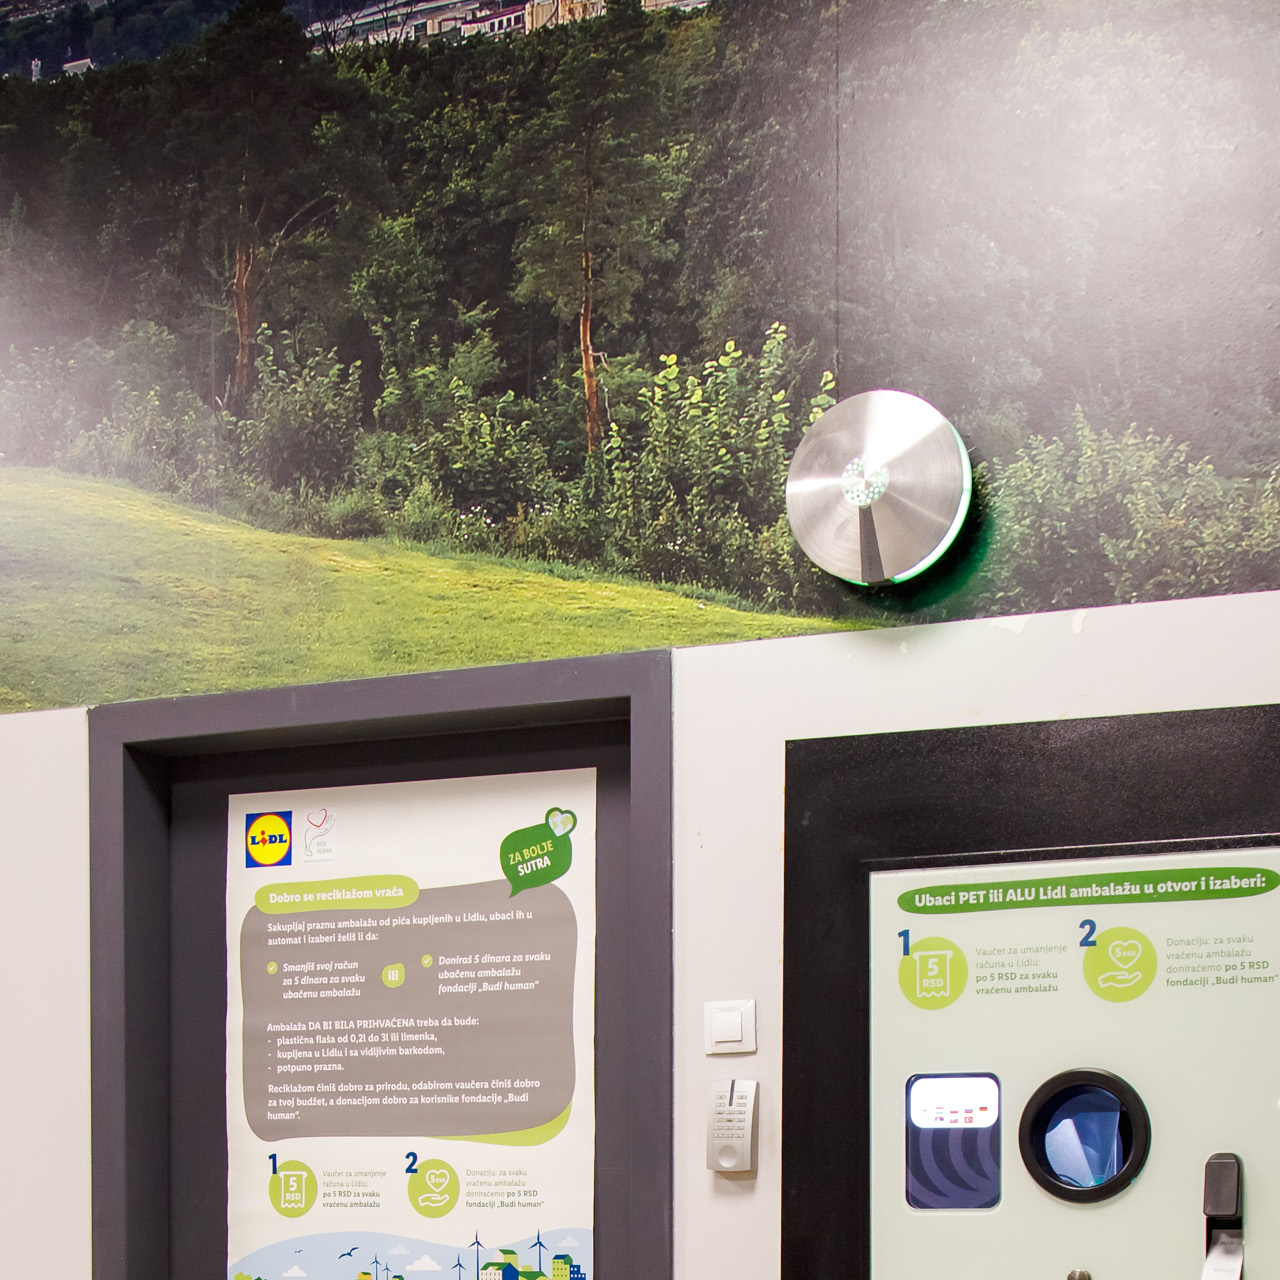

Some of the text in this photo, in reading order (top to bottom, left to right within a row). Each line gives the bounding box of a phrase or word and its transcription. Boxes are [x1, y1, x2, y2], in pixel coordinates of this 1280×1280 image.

[508, 840, 554, 865] ZA BOLJE
[517, 856, 551, 876] SUTRA
[269, 886, 404, 904] Dobro se reciklažom vraća
[915, 873, 1266, 907] Ubaci PET ili ALU Lidl ambalažu u otvor i izaberi:
[267, 910, 533, 933] Sakupljaj praznu ambalažu od pića kupljenih u Lidlu, ubaci ih u
[898, 930, 910, 956] 1
[1079, 919, 1097, 947] 2
[927, 958, 939, 976] 5
[975, 975, 988, 984] po
[989, 972, 996, 982] 5
[997, 972, 1017, 981] RSD
[1031, 970, 1058, 980] svaku
[922, 978, 944, 988] RSD
[266, 1016, 480, 1032] Ambalaža DA BI BILA PRIHVAĆENA treba da bude:
[268, 1154, 278, 1174] 1
[405, 1152, 418, 1173] 2
[289, 1177, 297, 1191] 5
[286, 1192, 301, 1200] RSD
